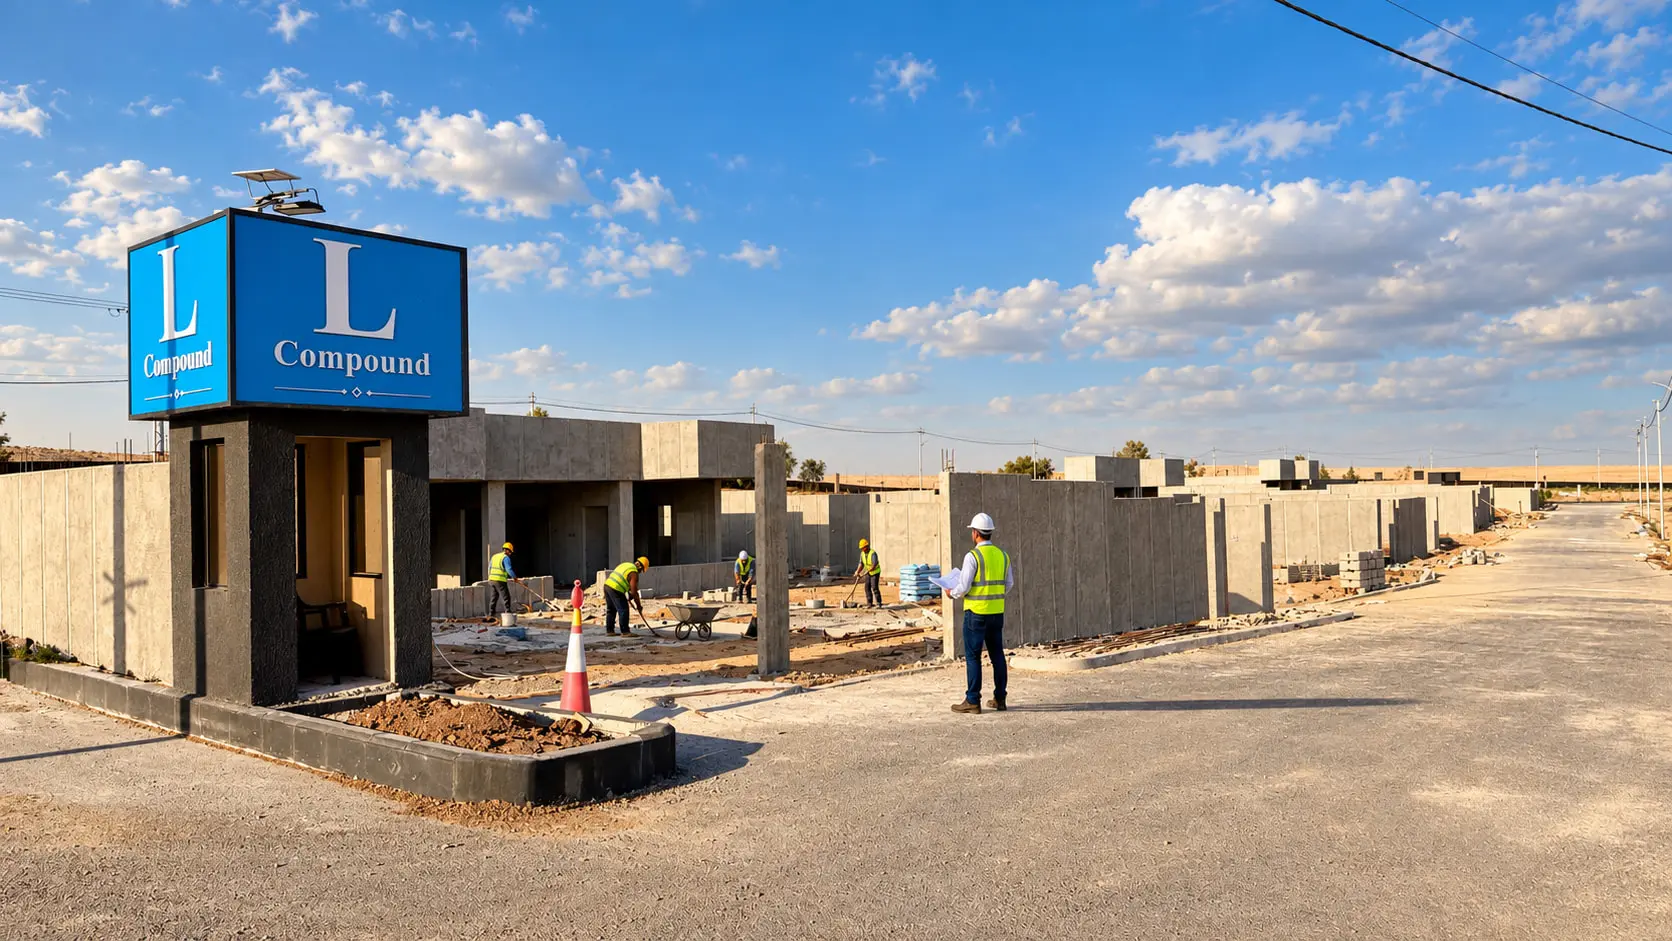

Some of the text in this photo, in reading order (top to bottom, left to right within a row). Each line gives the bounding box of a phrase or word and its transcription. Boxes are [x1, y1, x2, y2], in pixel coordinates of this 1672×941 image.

[157, 244, 198, 343] L
[312, 237, 397, 340] L
[143, 340, 213, 380] Compound
[273, 339, 432, 378] Compound
